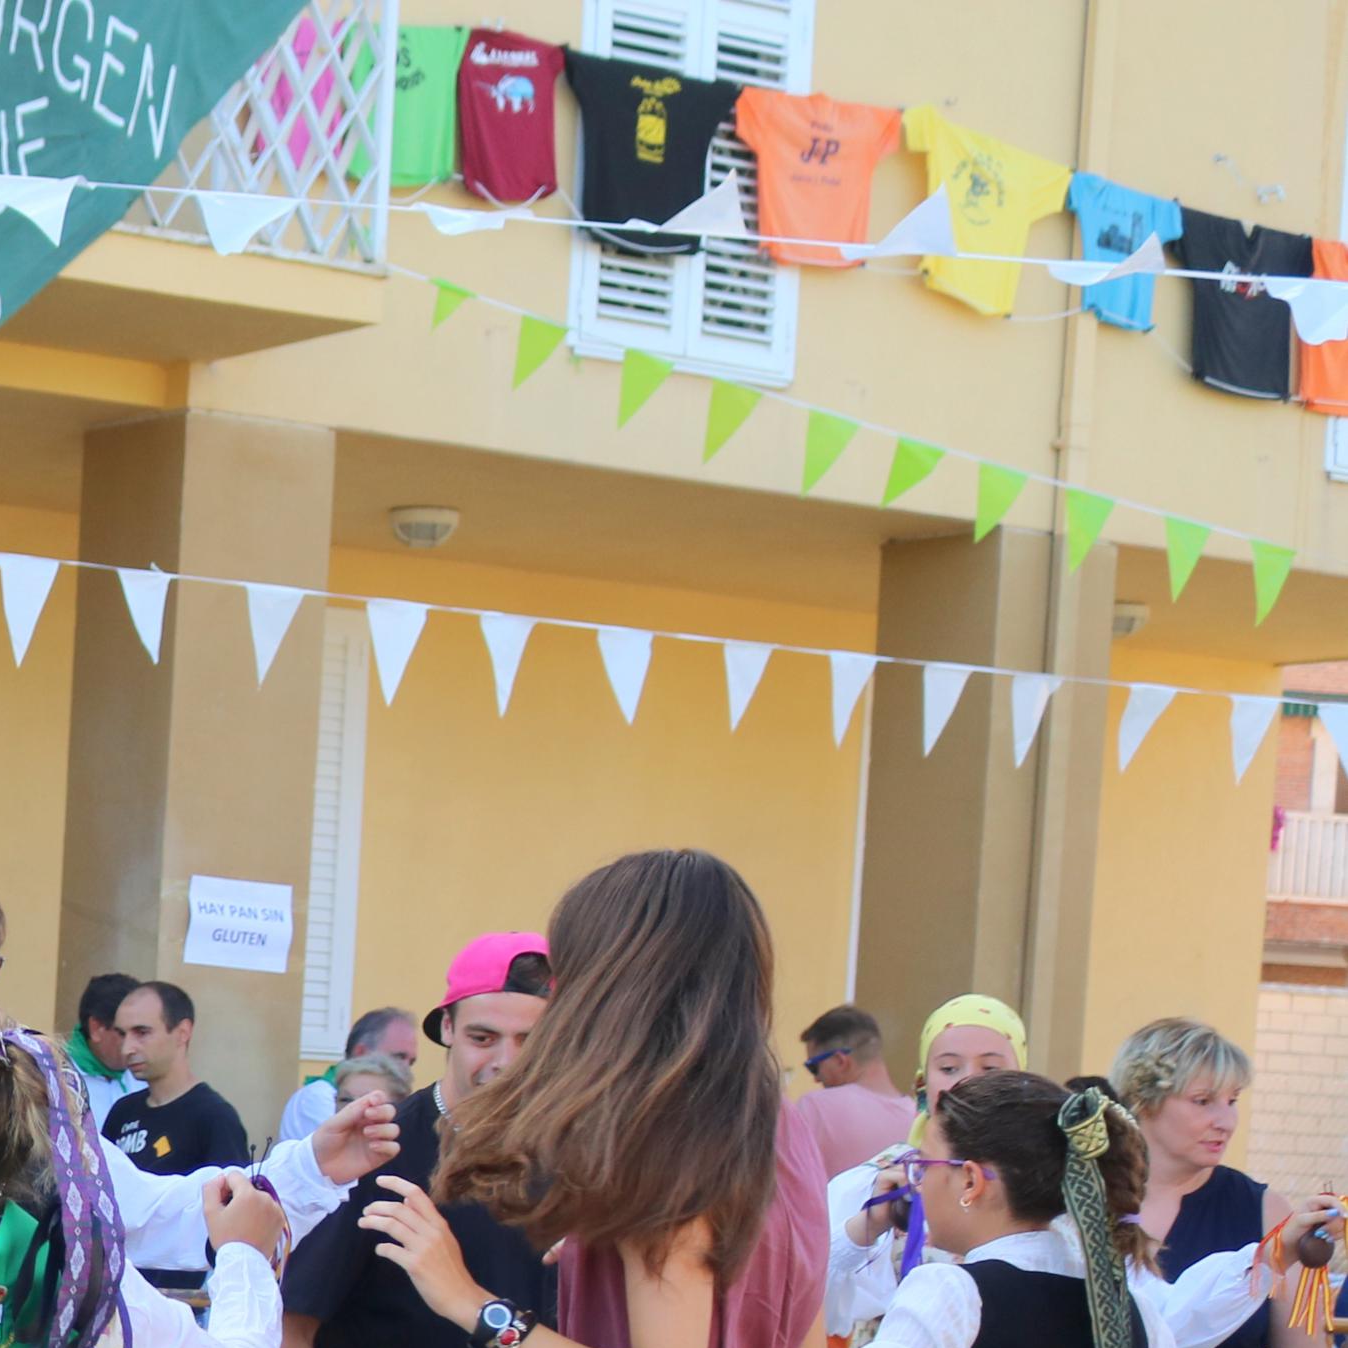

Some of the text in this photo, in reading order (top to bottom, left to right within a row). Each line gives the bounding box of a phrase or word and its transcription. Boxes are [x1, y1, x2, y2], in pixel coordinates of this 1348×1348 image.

[197, 901, 285, 923] HAY PAN SIN
[212, 928, 268, 946] GLUTEN
